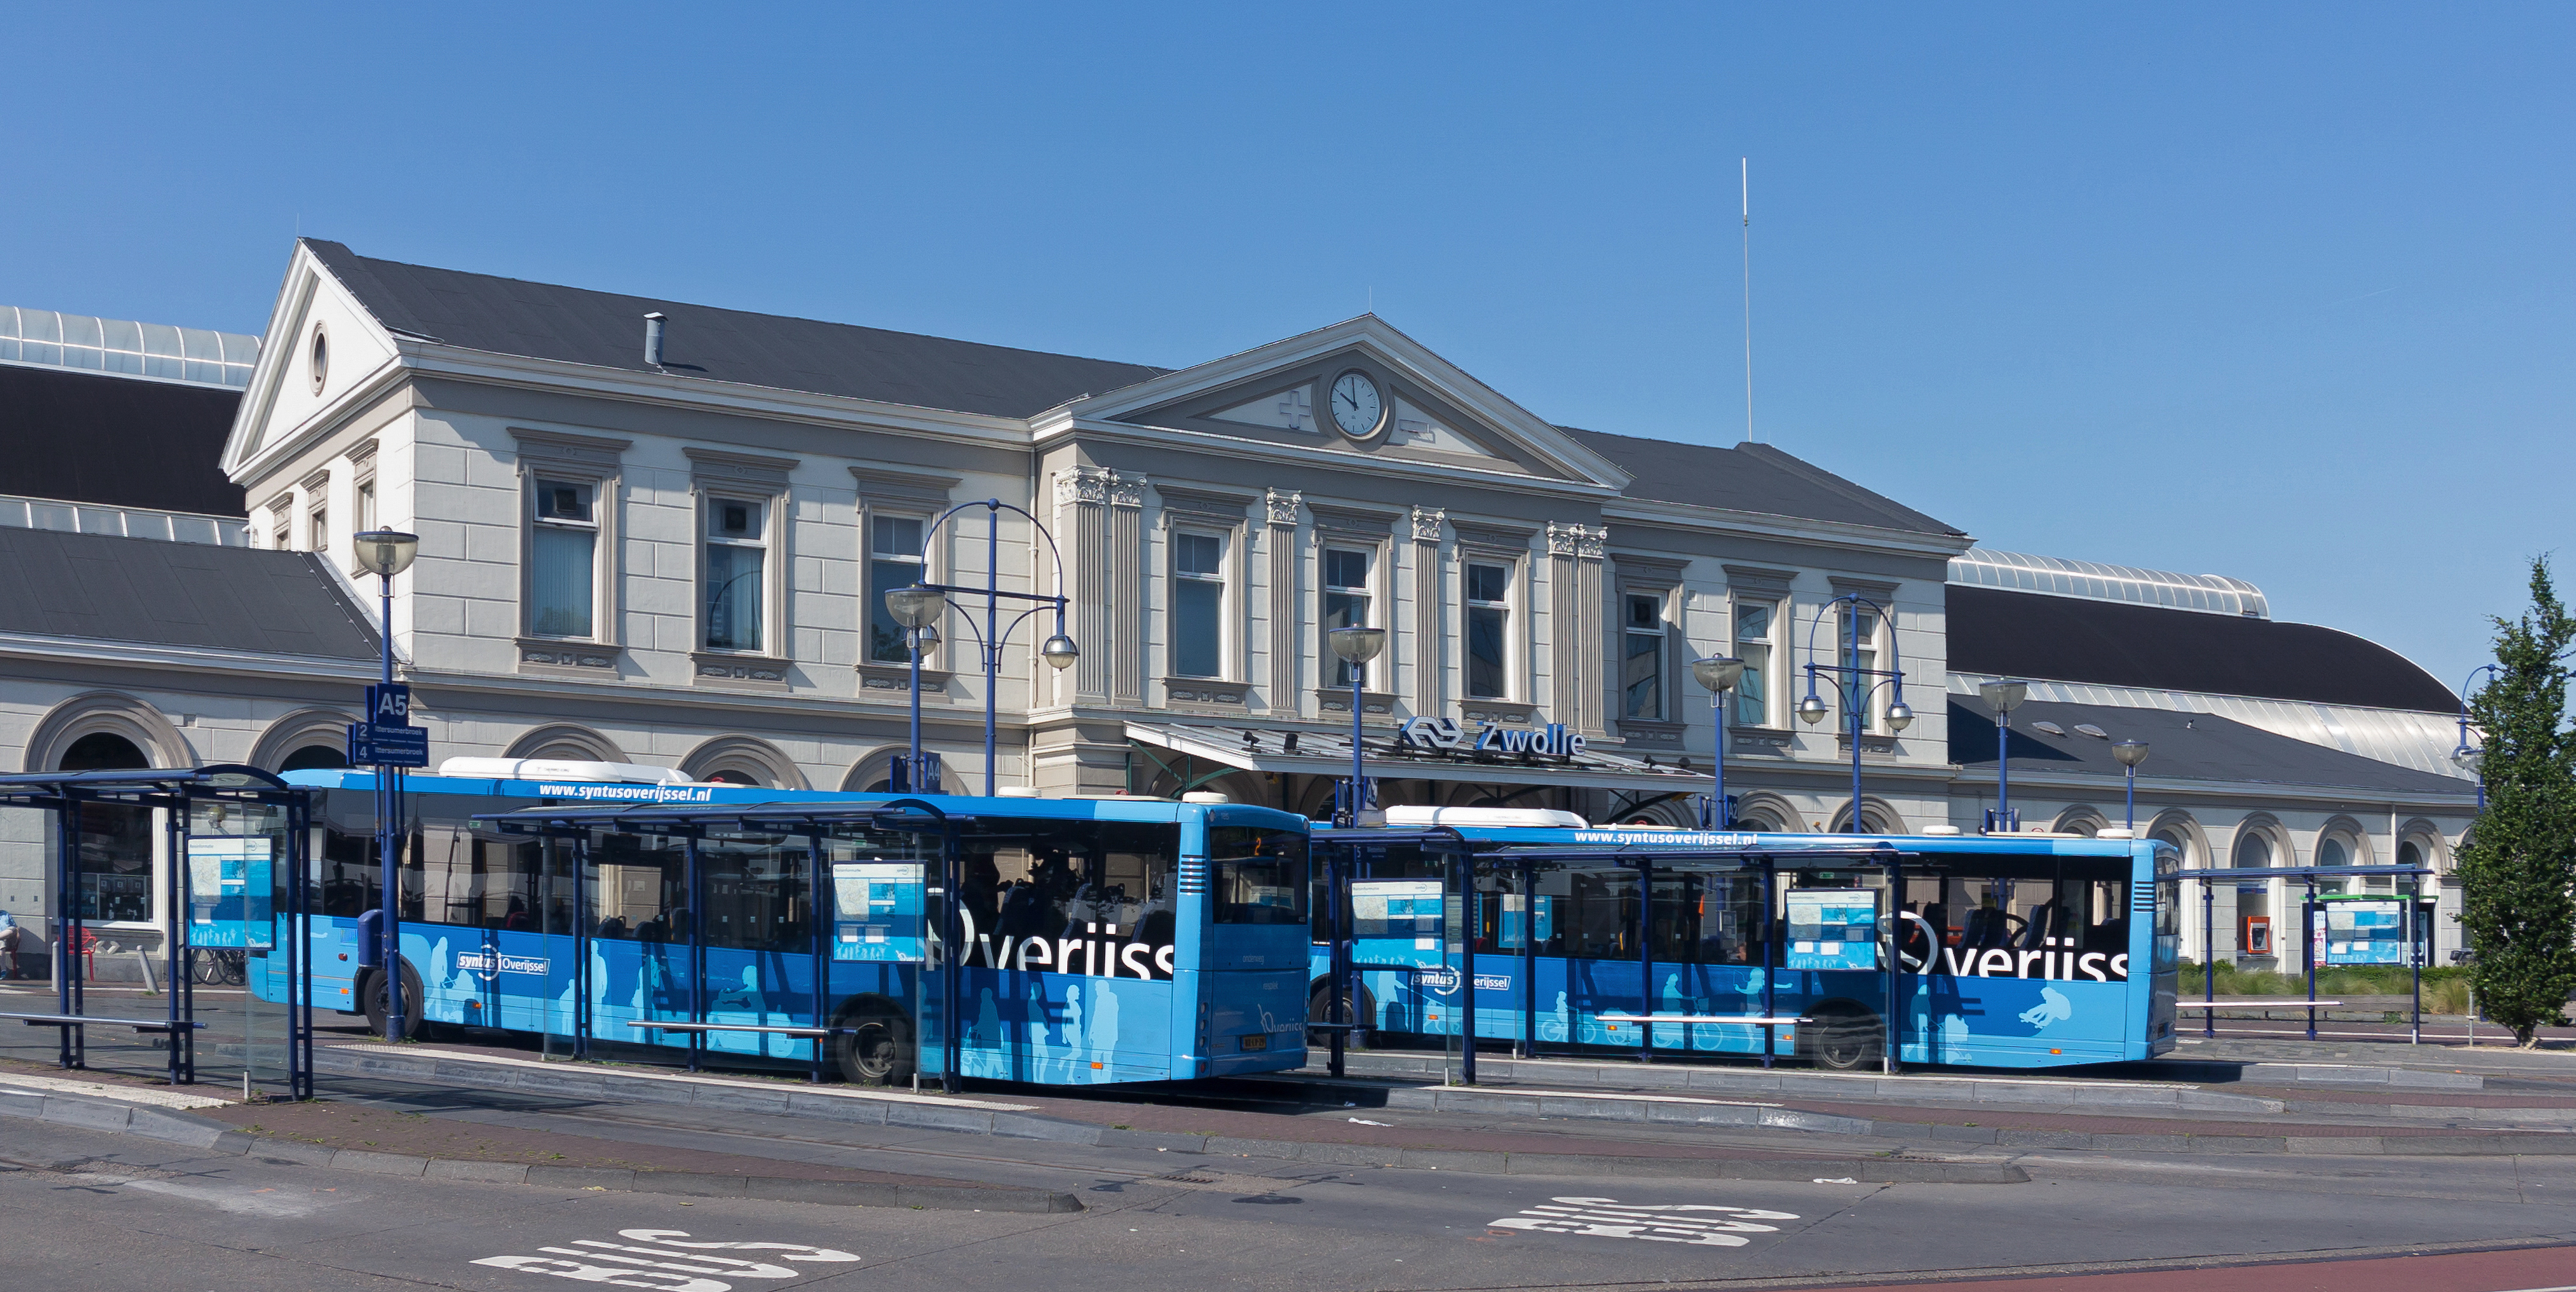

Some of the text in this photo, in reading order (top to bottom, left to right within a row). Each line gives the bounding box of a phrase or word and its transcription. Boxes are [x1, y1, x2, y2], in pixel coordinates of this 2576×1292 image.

[379, 692, 407, 716] A5
[360, 724, 367, 737] 2
[1479, 720, 1587, 756] Zwolle
[359, 746, 367, 758] 4
[927, 760, 940, 781] A4
[540, 784, 712, 803] www.syntusoverijssel.nl
[1728, 802, 1738, 819] A2
[1254, 837, 1261, 856] 2
[1575, 832, 1758, 845] www.syntusoverijssel.nl
[459, 955, 547, 974] syntus Overijssel
[1414, 972, 1507, 989] syntus erijssel
[1487, 1197, 1801, 1247] BUS
[468, 1229, 861, 1292] BUS
